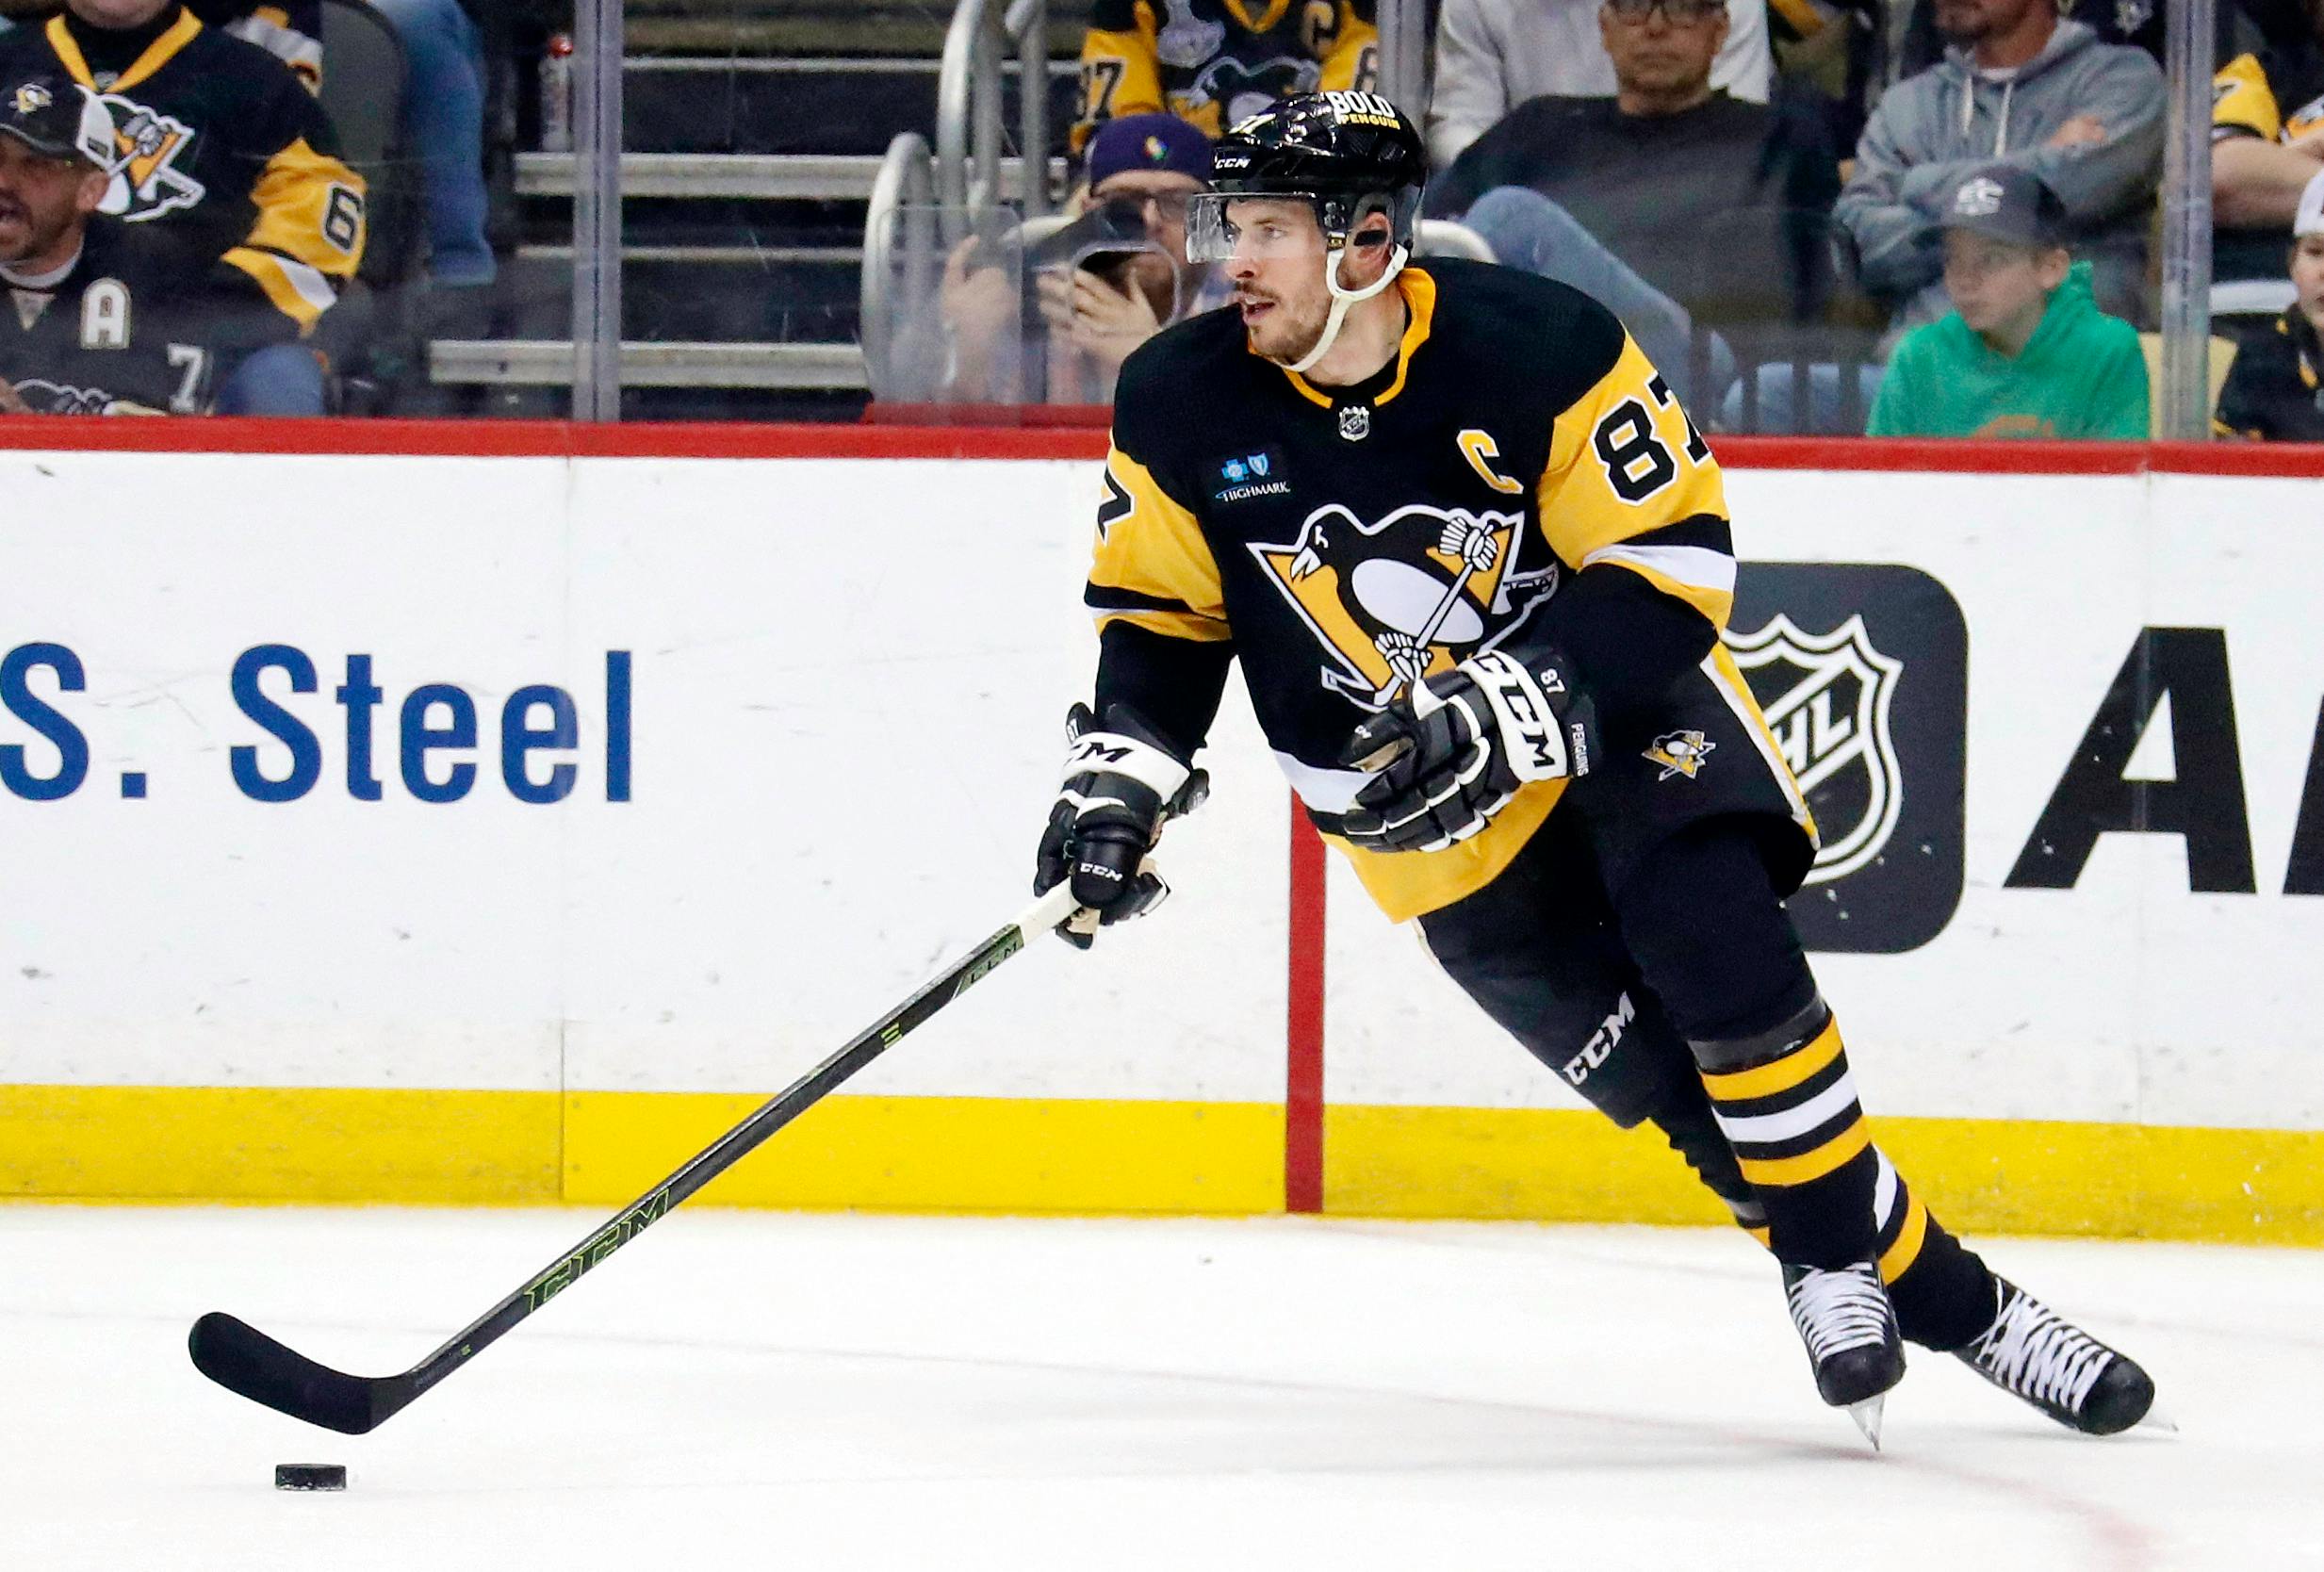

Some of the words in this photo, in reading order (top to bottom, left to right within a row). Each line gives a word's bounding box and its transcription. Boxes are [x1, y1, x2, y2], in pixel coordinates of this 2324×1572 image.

[1324, 90, 1395, 123] BOLD
[1341, 113, 1400, 129] PENGUIN
[1215, 157, 1251, 169] CCM
[80, 277, 131, 350] A
[1590, 365, 1713, 506] 87
[1456, 429, 1524, 494] C
[1221, 481, 1290, 502] HIGHMARK
[229, 644, 632, 804] Steel
[1080, 861, 1124, 882] CCM
[1563, 991, 1636, 1085] CCM
